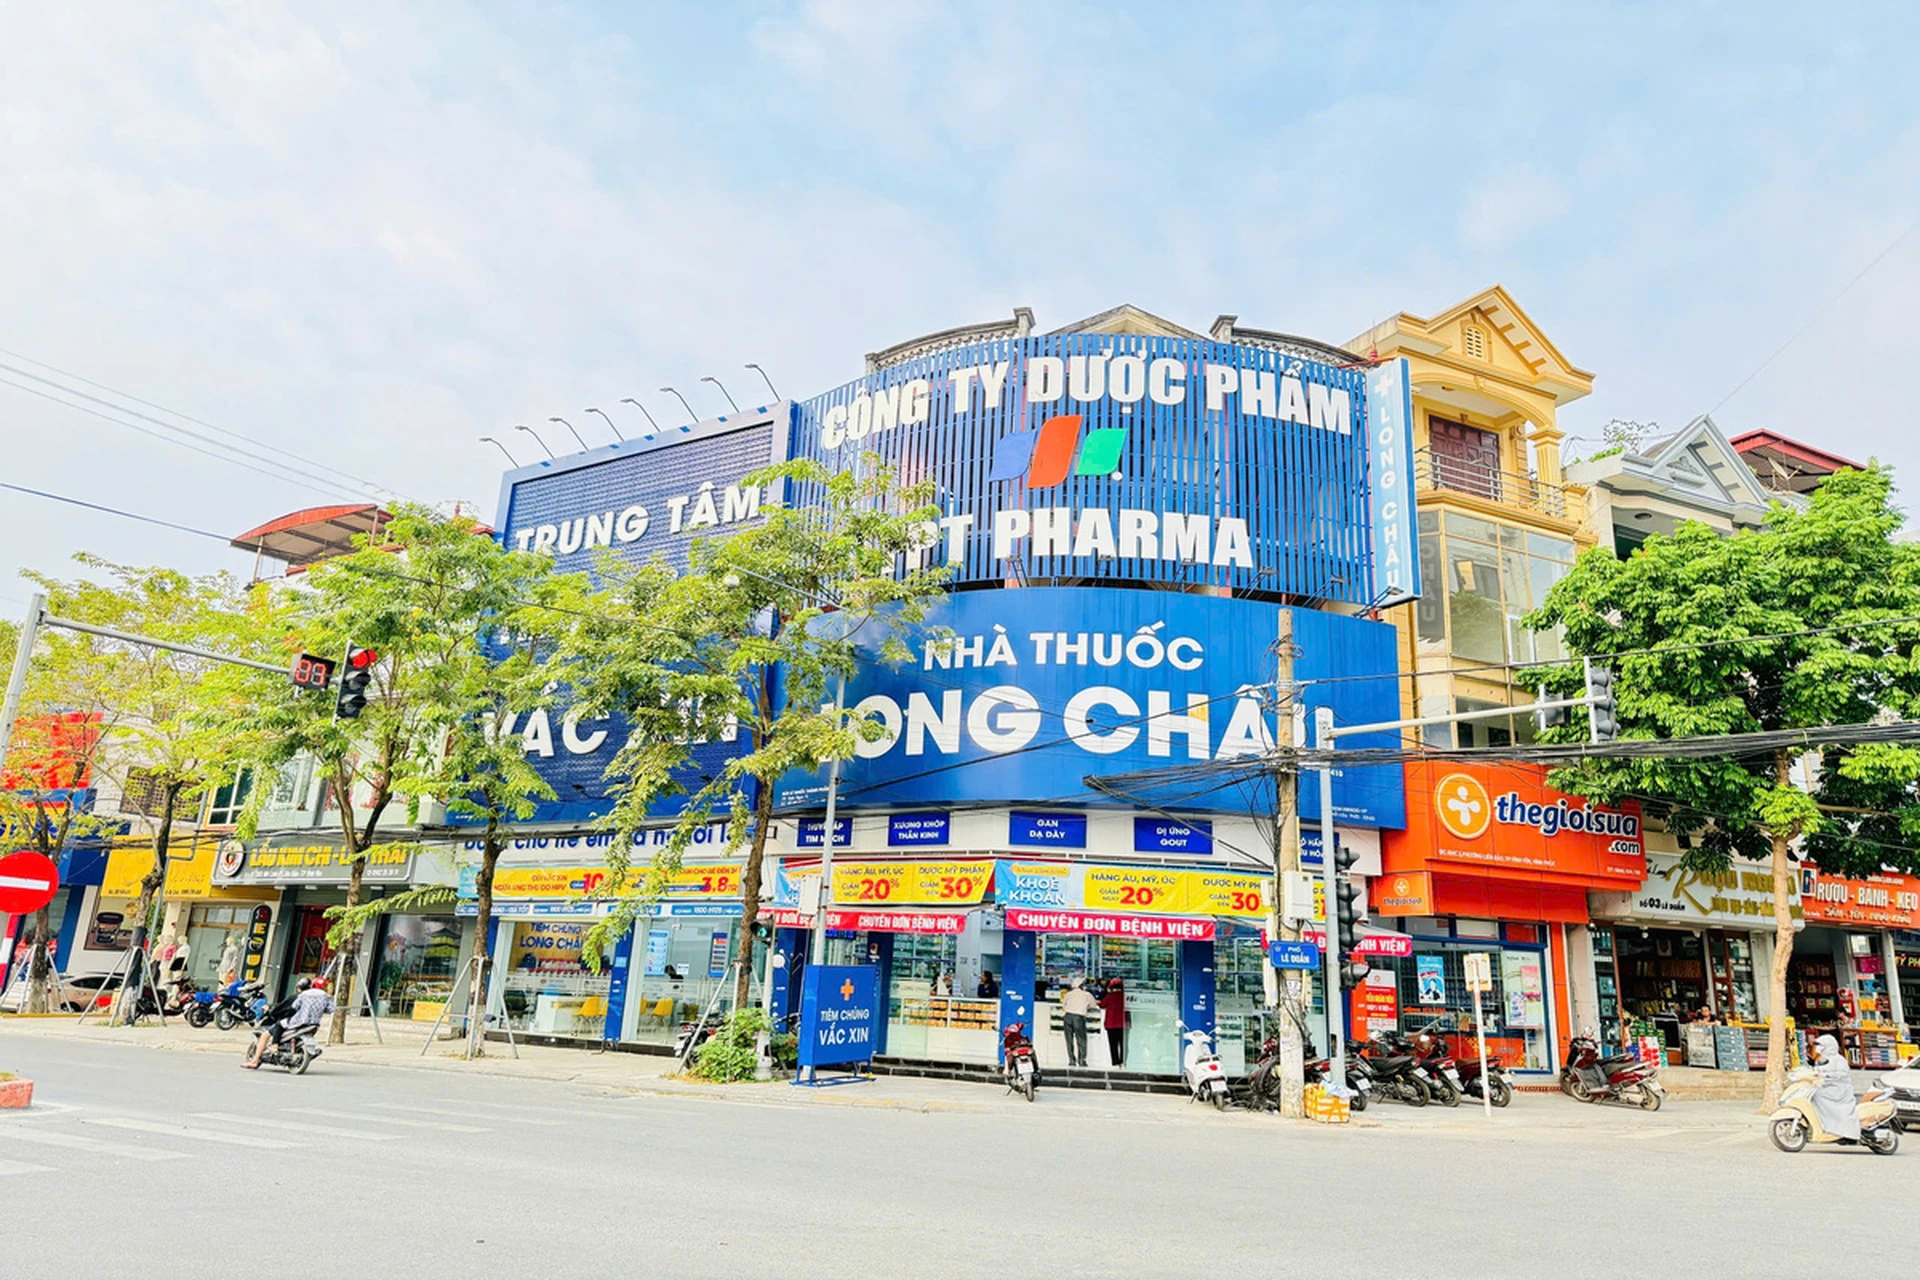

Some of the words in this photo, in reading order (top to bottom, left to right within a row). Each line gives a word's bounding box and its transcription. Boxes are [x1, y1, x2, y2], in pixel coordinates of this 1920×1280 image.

[822, 379, 930, 450] CÔNG
[949, 360, 1009, 414] TY
[1028, 348, 1186, 414] DƯỢC
[1207, 358, 1351, 435] PHẨM
[1378, 407, 1397, 489] LONG
[515, 505, 649, 555] TRUNG
[667, 481, 761, 534] TÂM
[994, 506, 1254, 569] PHARMA
[924, 624, 1019, 671] NHÀ
[1030, 619, 1204, 671] THUỐC
[1494, 792, 1638, 838] thegioisua
[805, 834, 818, 843] TIM
[920, 831, 939, 839] KINH
[1160, 838, 1188, 847] GOUT
[304, 845, 333, 866] CHI
[1608, 840, 1640, 855] .com
[1091, 872, 1121, 883] HÀNG
[1018, 914, 1079, 930] CHUYÊN
[1083, 918, 1116, 932] ĐƠN
[1120, 917, 1163, 937] BỆNH
[1167, 921, 1204, 939] VIỆN
[520, 935, 554, 949] LONG
[1380, 937, 1407, 955] VIỆN
[820, 1006, 838, 1022] TIÊM
[840, 1005, 870, 1021] CHỦNG
[819, 1021, 845, 1046] VẮC
[848, 1027, 870, 1043] XIN
